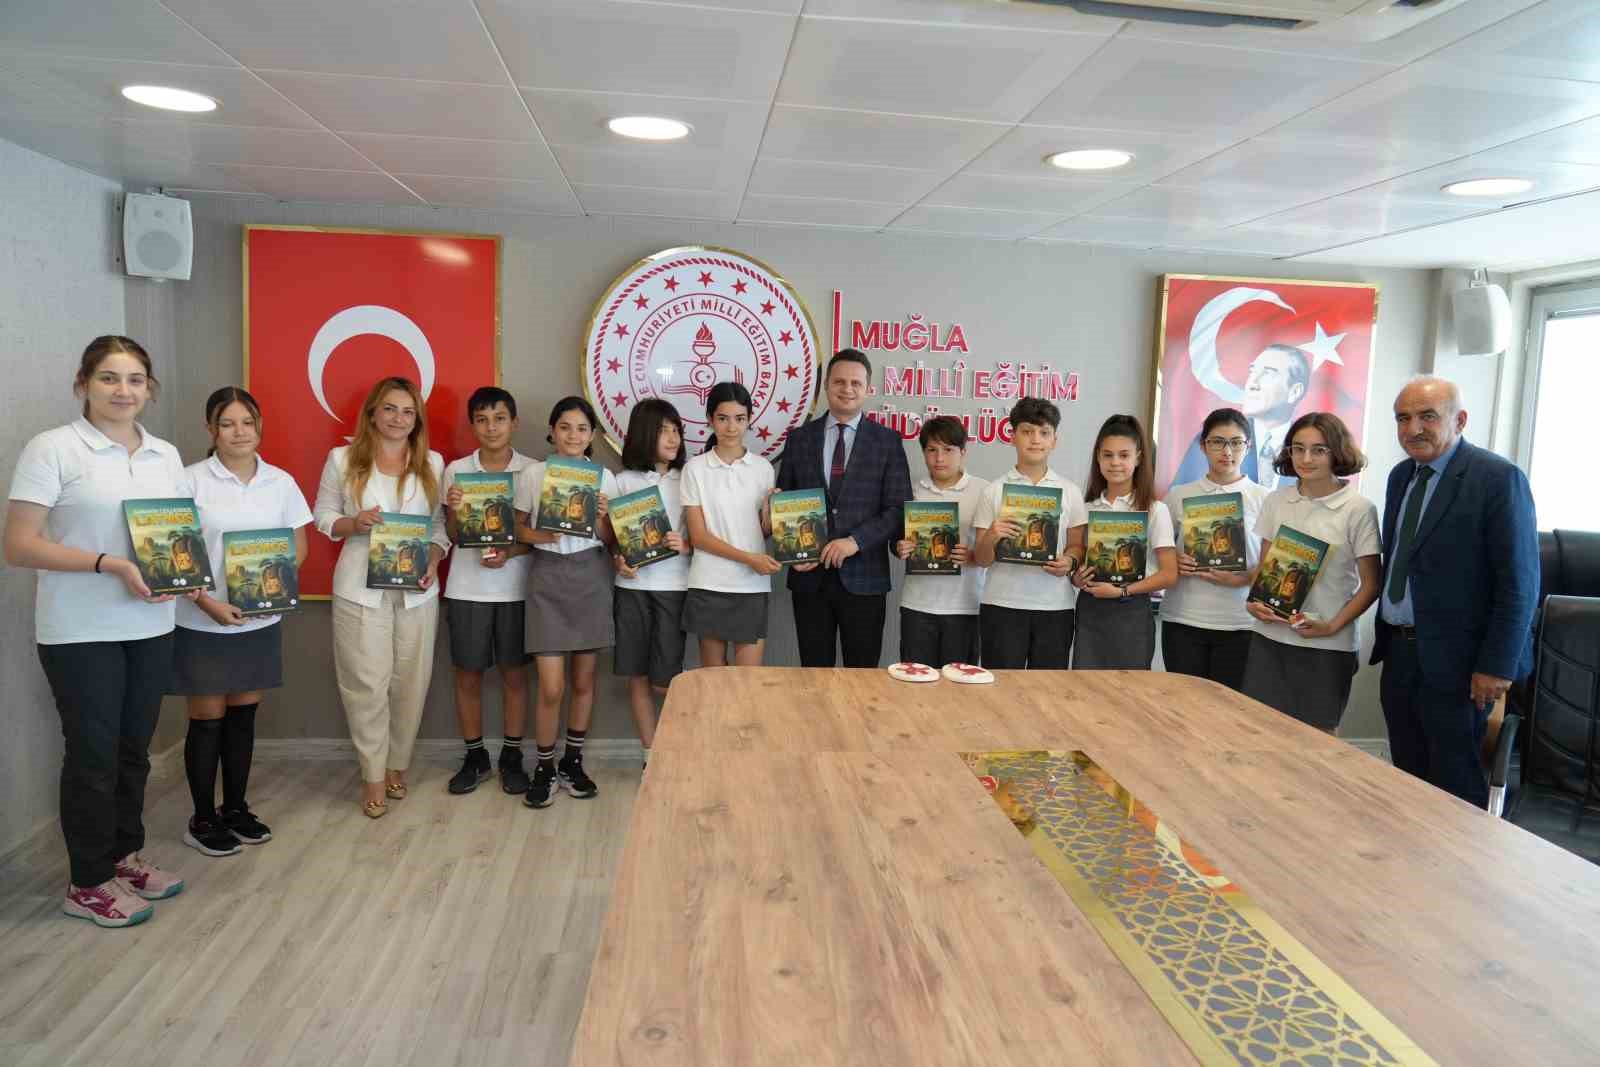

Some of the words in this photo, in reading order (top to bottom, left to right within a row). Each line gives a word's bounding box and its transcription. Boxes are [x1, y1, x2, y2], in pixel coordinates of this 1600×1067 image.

[741, 316, 772, 366] EĞİTİM
[851, 313, 969, 352] MUĞLA
[972, 362, 1081, 401] EĞİTİM
